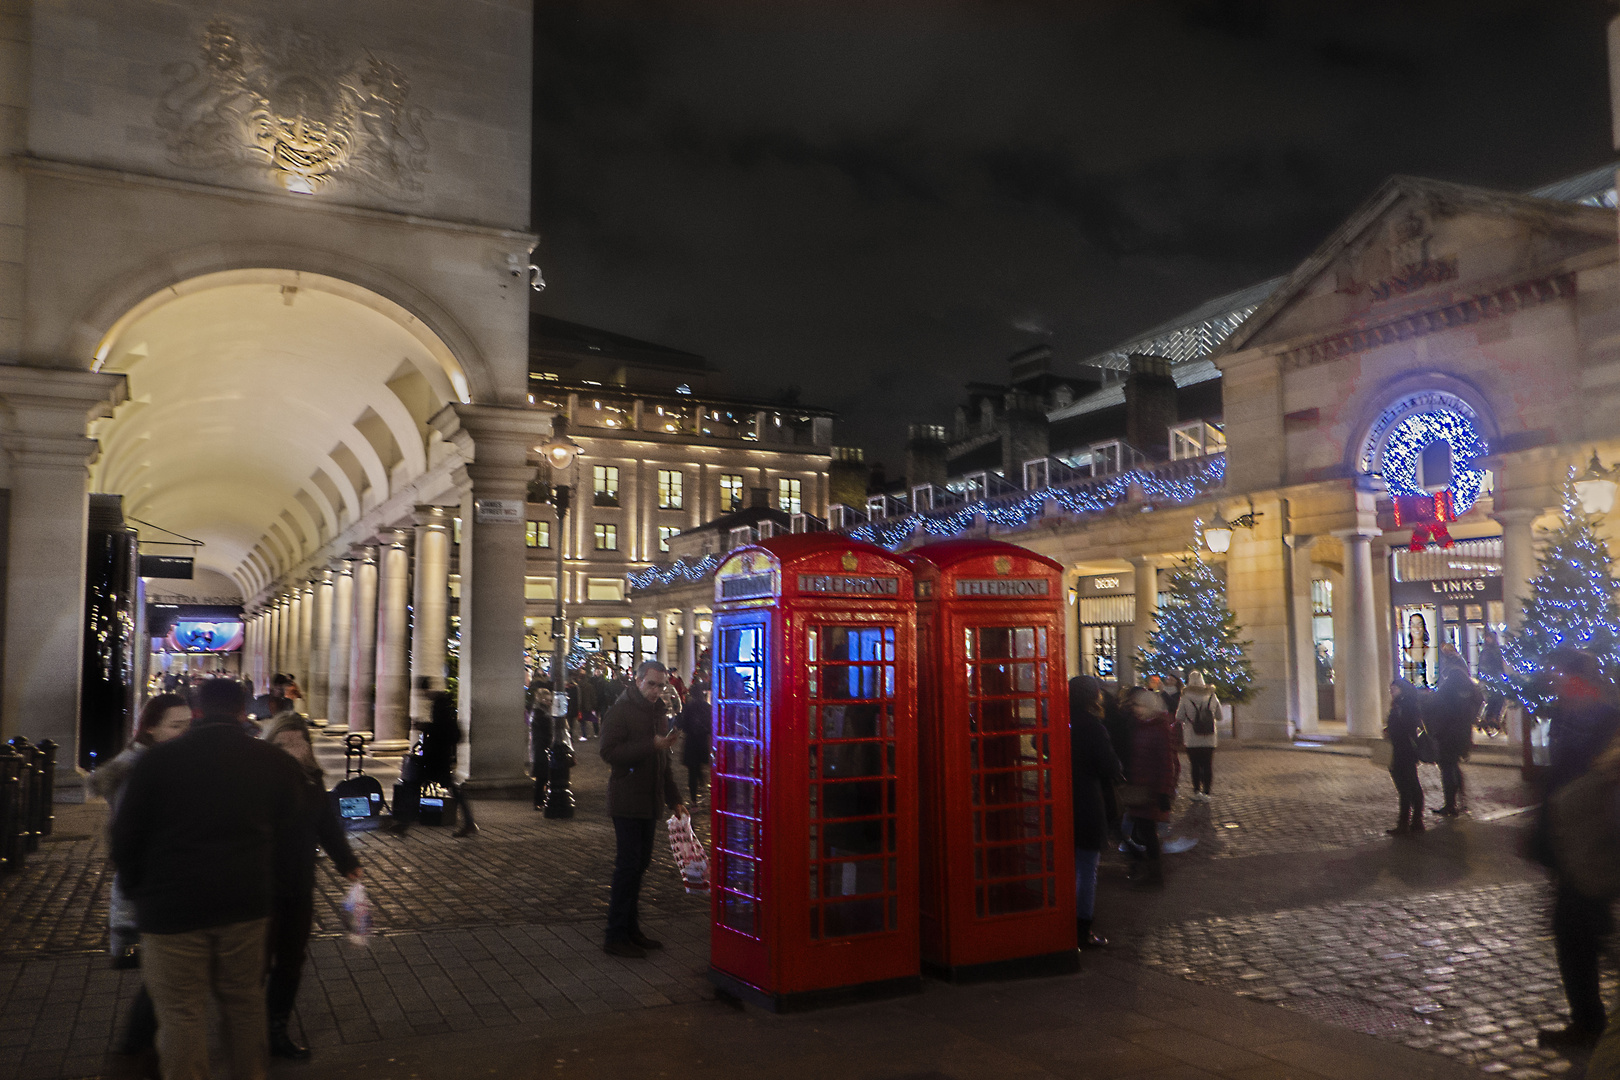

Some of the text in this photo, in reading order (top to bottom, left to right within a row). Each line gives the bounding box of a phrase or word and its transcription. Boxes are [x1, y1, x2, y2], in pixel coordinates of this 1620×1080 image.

[725, 577, 770, 593] TELEPHON
[800, 576, 894, 595] TELEPHONE
[960, 580, 1046, 596] TELEPHONE
[1432, 579, 1486, 593] LINKS
